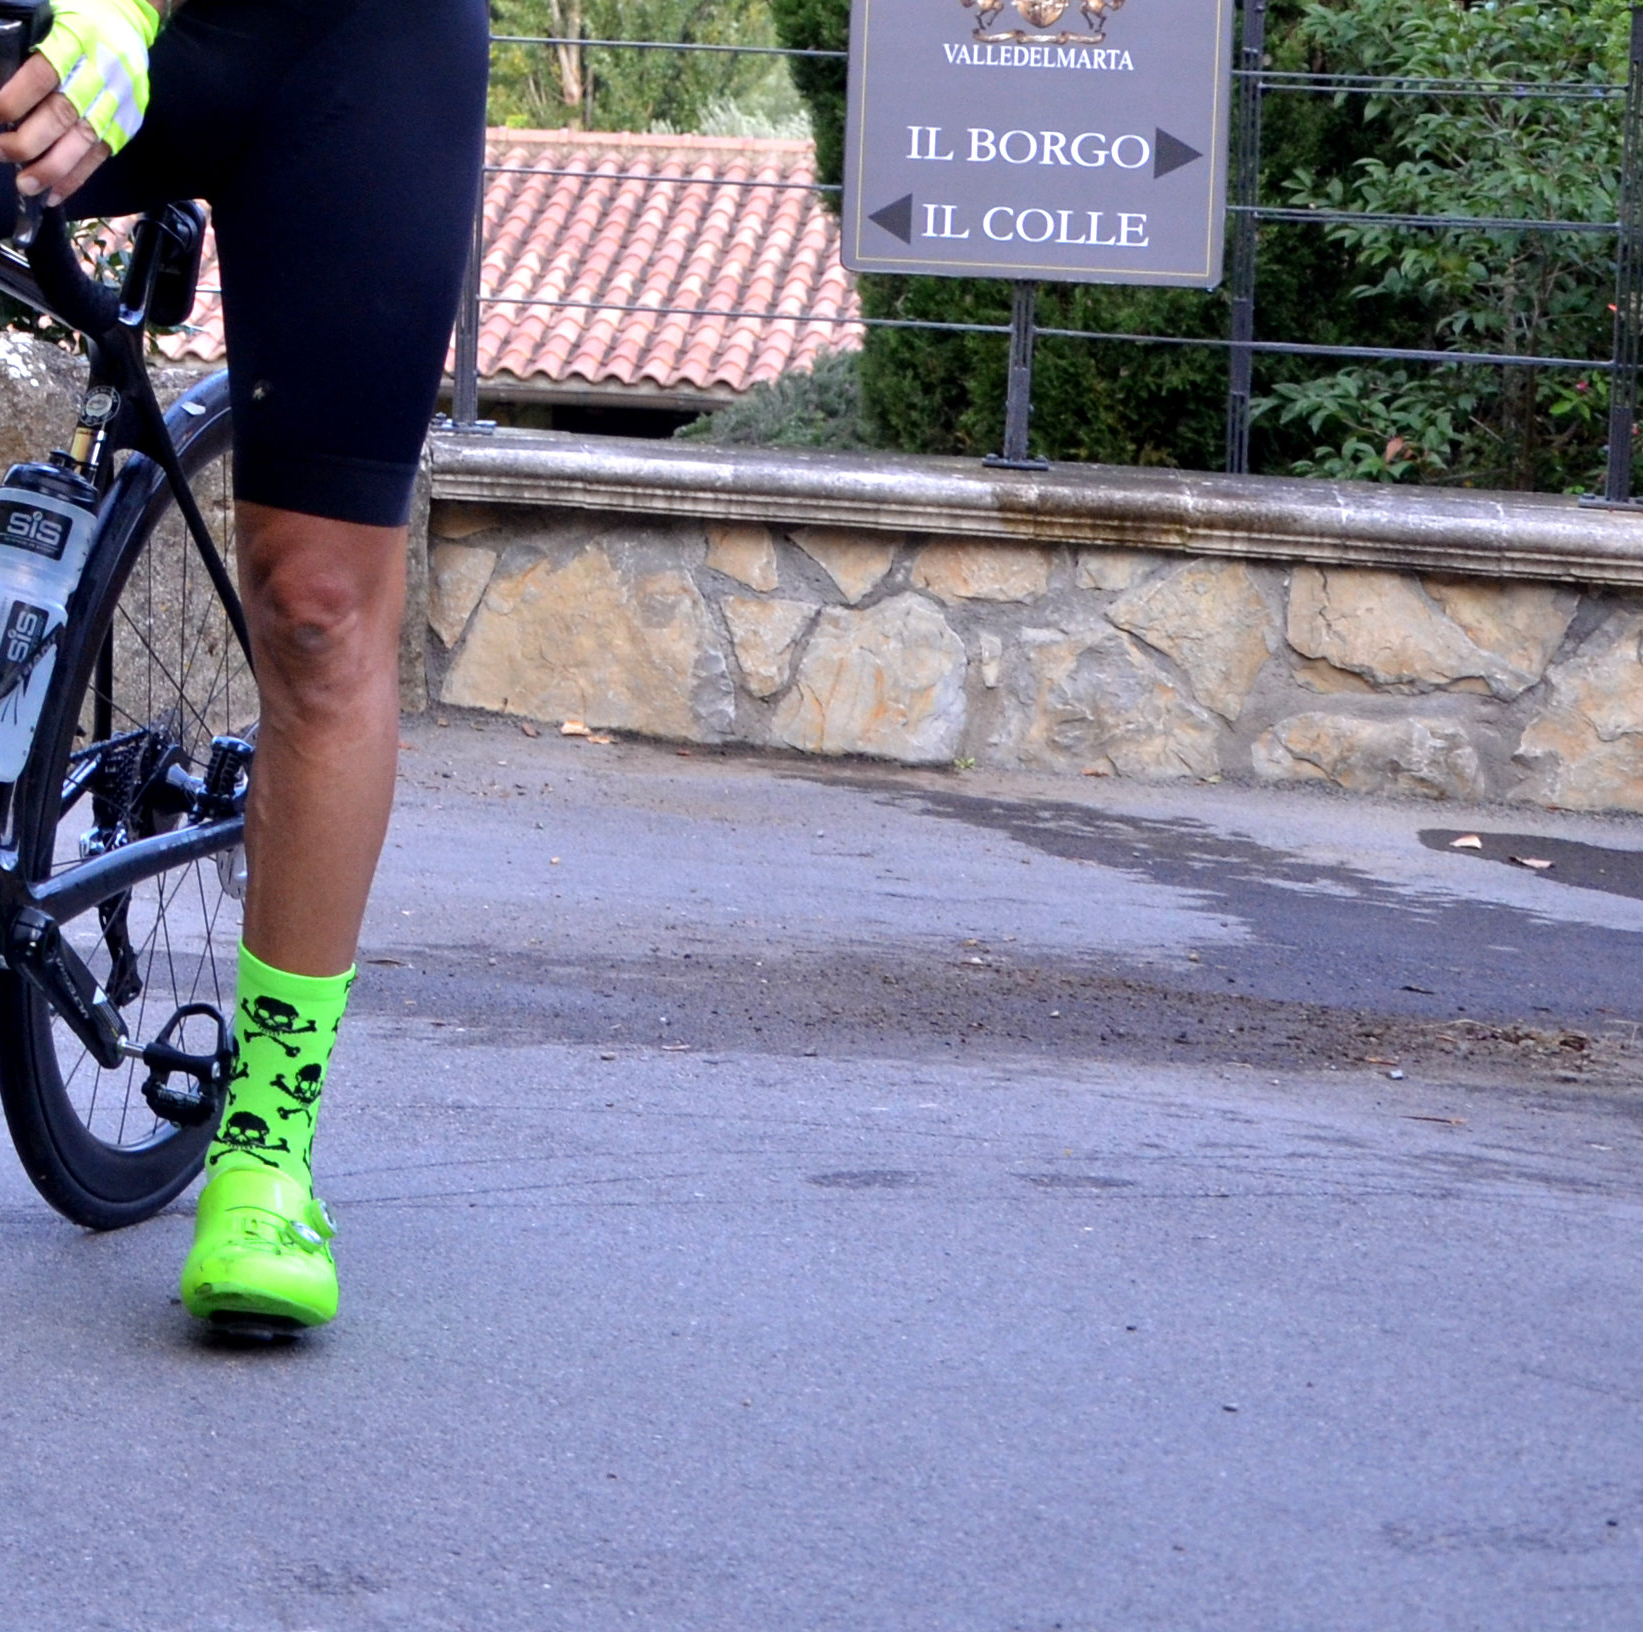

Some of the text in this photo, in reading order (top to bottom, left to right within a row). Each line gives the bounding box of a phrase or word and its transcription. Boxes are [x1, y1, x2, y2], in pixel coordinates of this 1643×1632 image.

[943, 42, 1135, 71] VALLEDELMARTA
[906, 125, 1150, 169] IL BORGO
[921, 203, 1149, 248] IL COLLE
